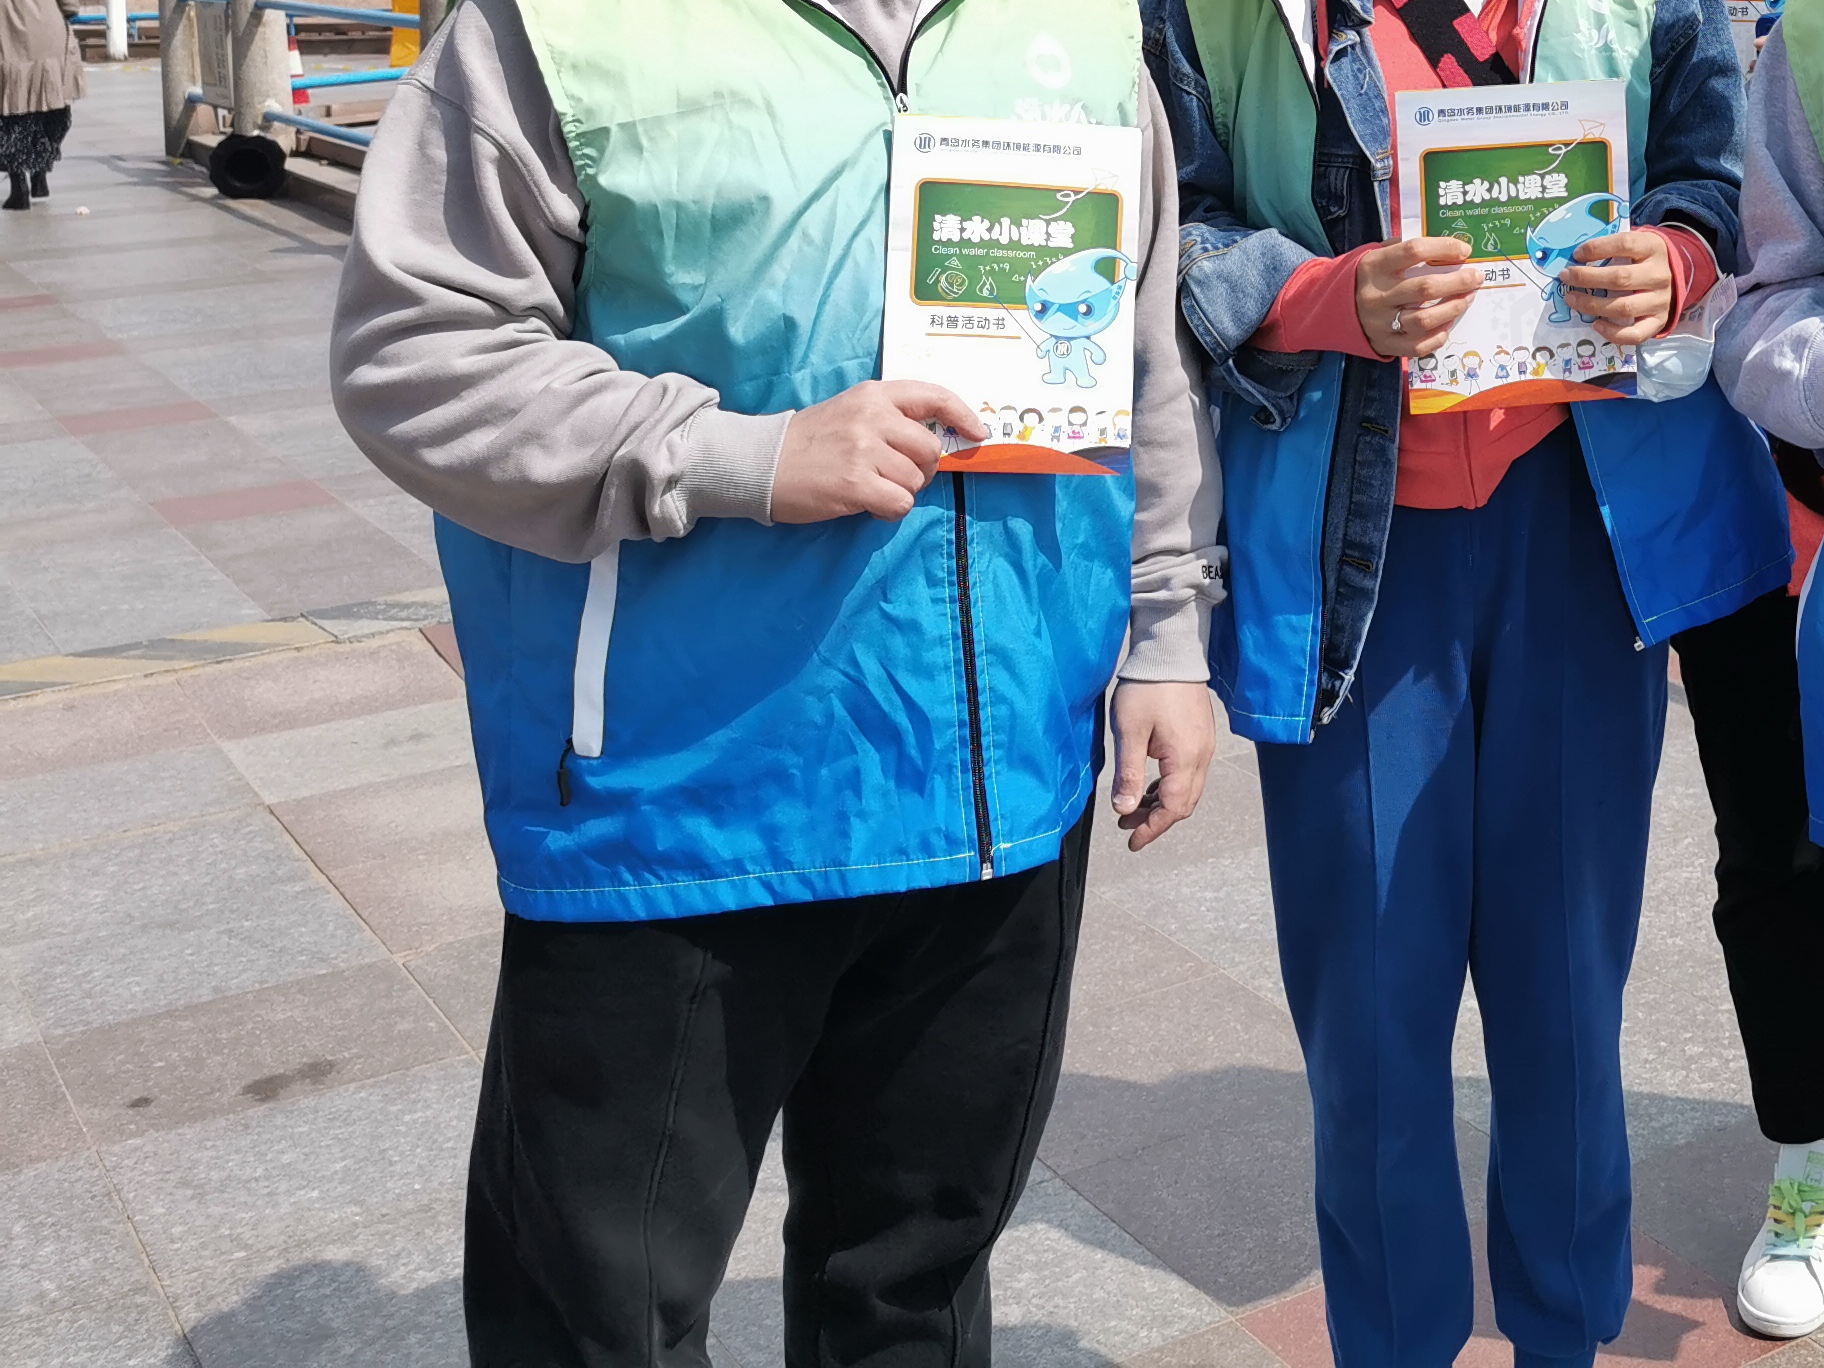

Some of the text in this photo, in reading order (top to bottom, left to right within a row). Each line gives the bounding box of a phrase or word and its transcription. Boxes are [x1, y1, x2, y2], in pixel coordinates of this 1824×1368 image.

[1437, 100, 1569, 118] 青岛水务集团环境能源有限公司
[939, 136, 1082, 156] 青岛水务集团环境能源有限公司
[1438, 173, 1569, 206] 清水小课堂
[1439, 204, 1534, 218] Clean water classroom
[932, 214, 1076, 249] 清水小课堂
[931, 245, 1037, 259] Clean water classroom
[929, 314, 1006, 331] 科普活动书
[1202, 565, 1223, 580] BEA
